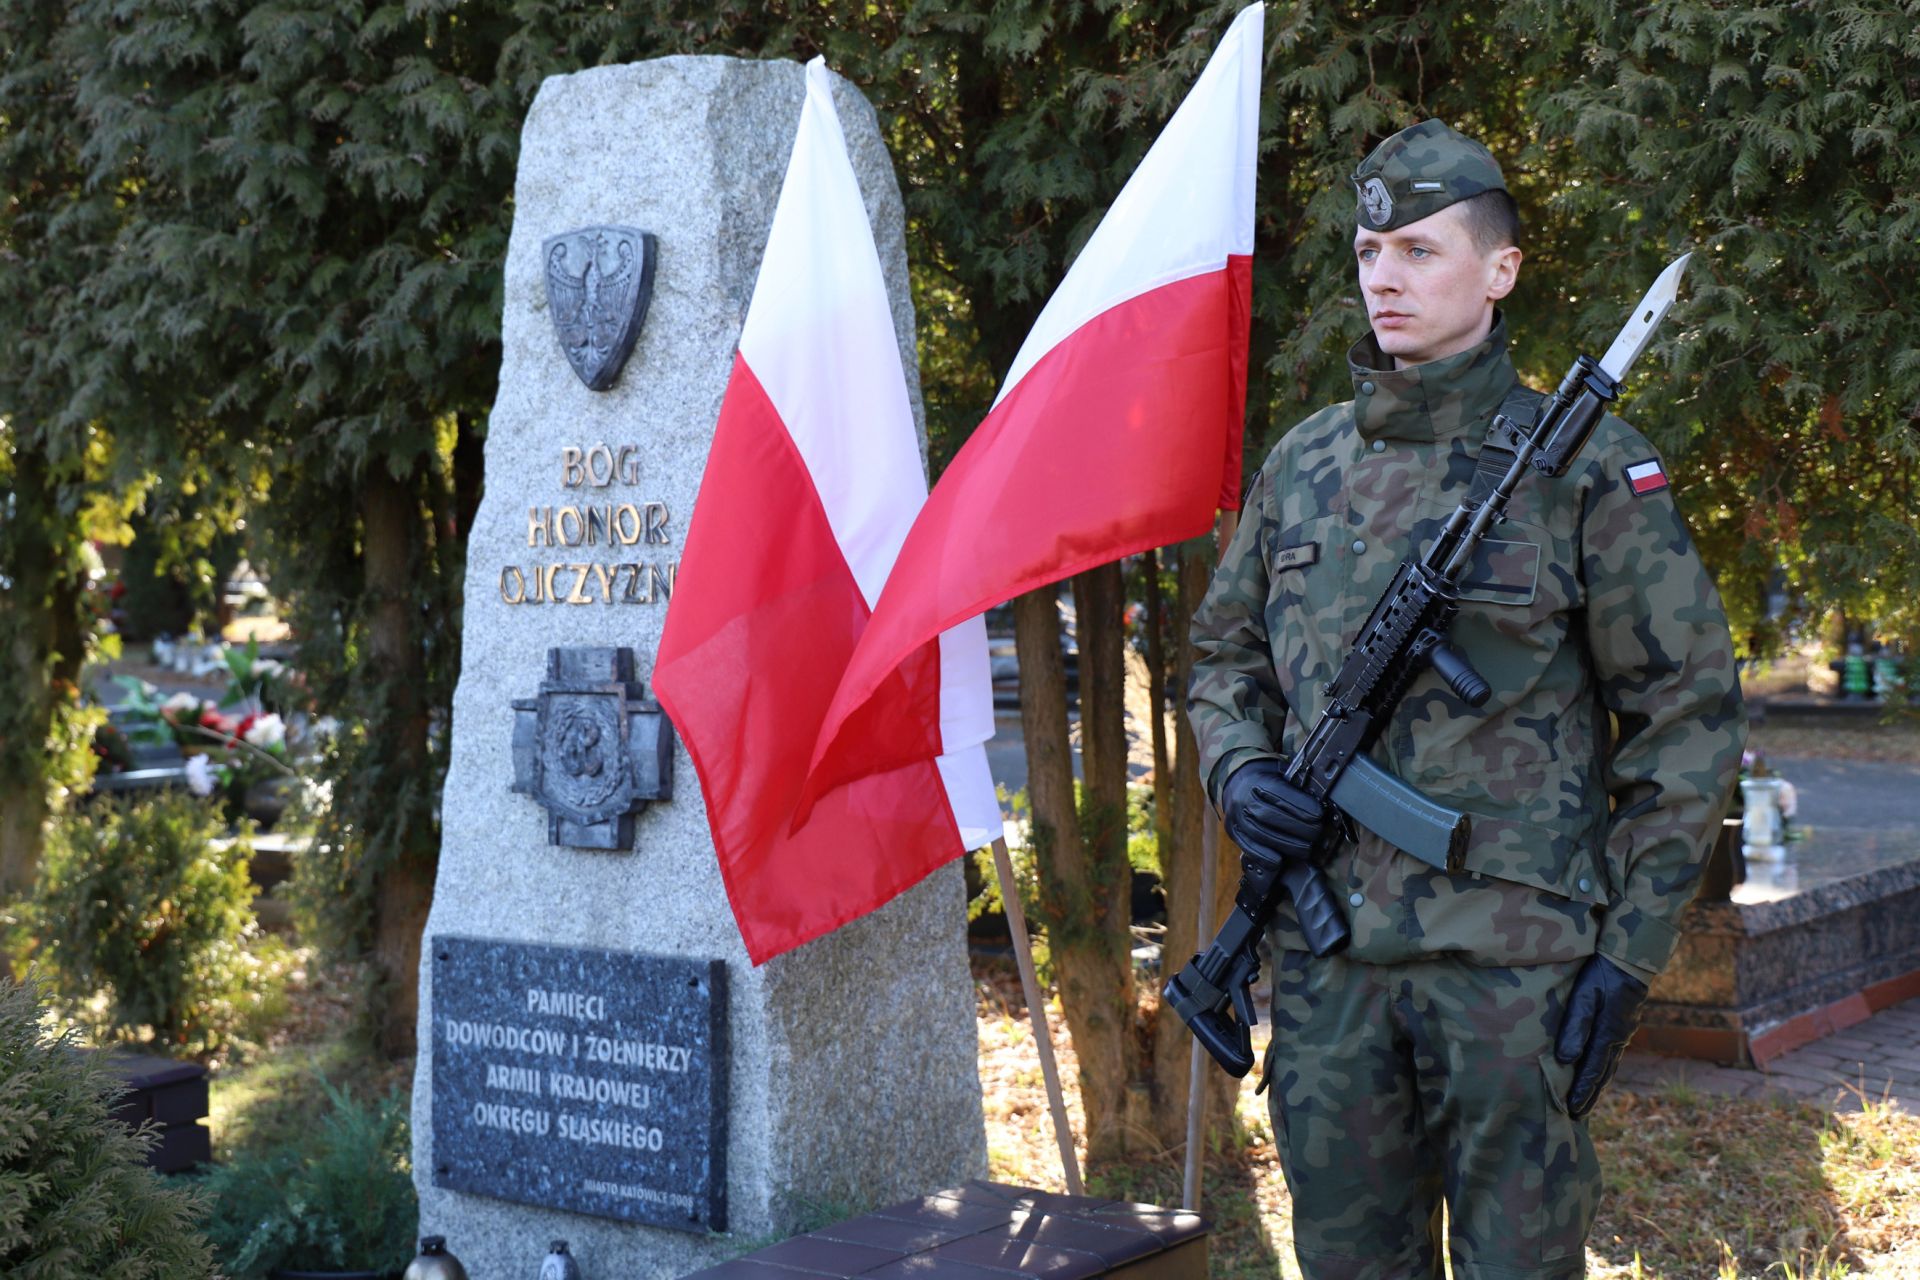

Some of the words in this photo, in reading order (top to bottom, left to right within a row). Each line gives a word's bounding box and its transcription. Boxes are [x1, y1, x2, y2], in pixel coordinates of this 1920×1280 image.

[562, 440, 639, 488] BÓG
[528, 502, 670, 547] HONOR
[500, 561, 676, 605] OJCZYZN
[527, 988, 605, 1021] PAMIĘCI
[572, 1034, 579, 1059] I
[585, 1031, 692, 1073] ŻOŁNIERZY
[486, 1064, 541, 1096] ARMII
[550, 1072, 650, 1109] KRAJOWEJ
[474, 1102, 550, 1136] OKRĘGU
[558, 1108, 663, 1152] ŚLĄSKIEGO
[583, 1179, 618, 1195] MIASTO
[620, 1184, 667, 1205] KATOWICE
